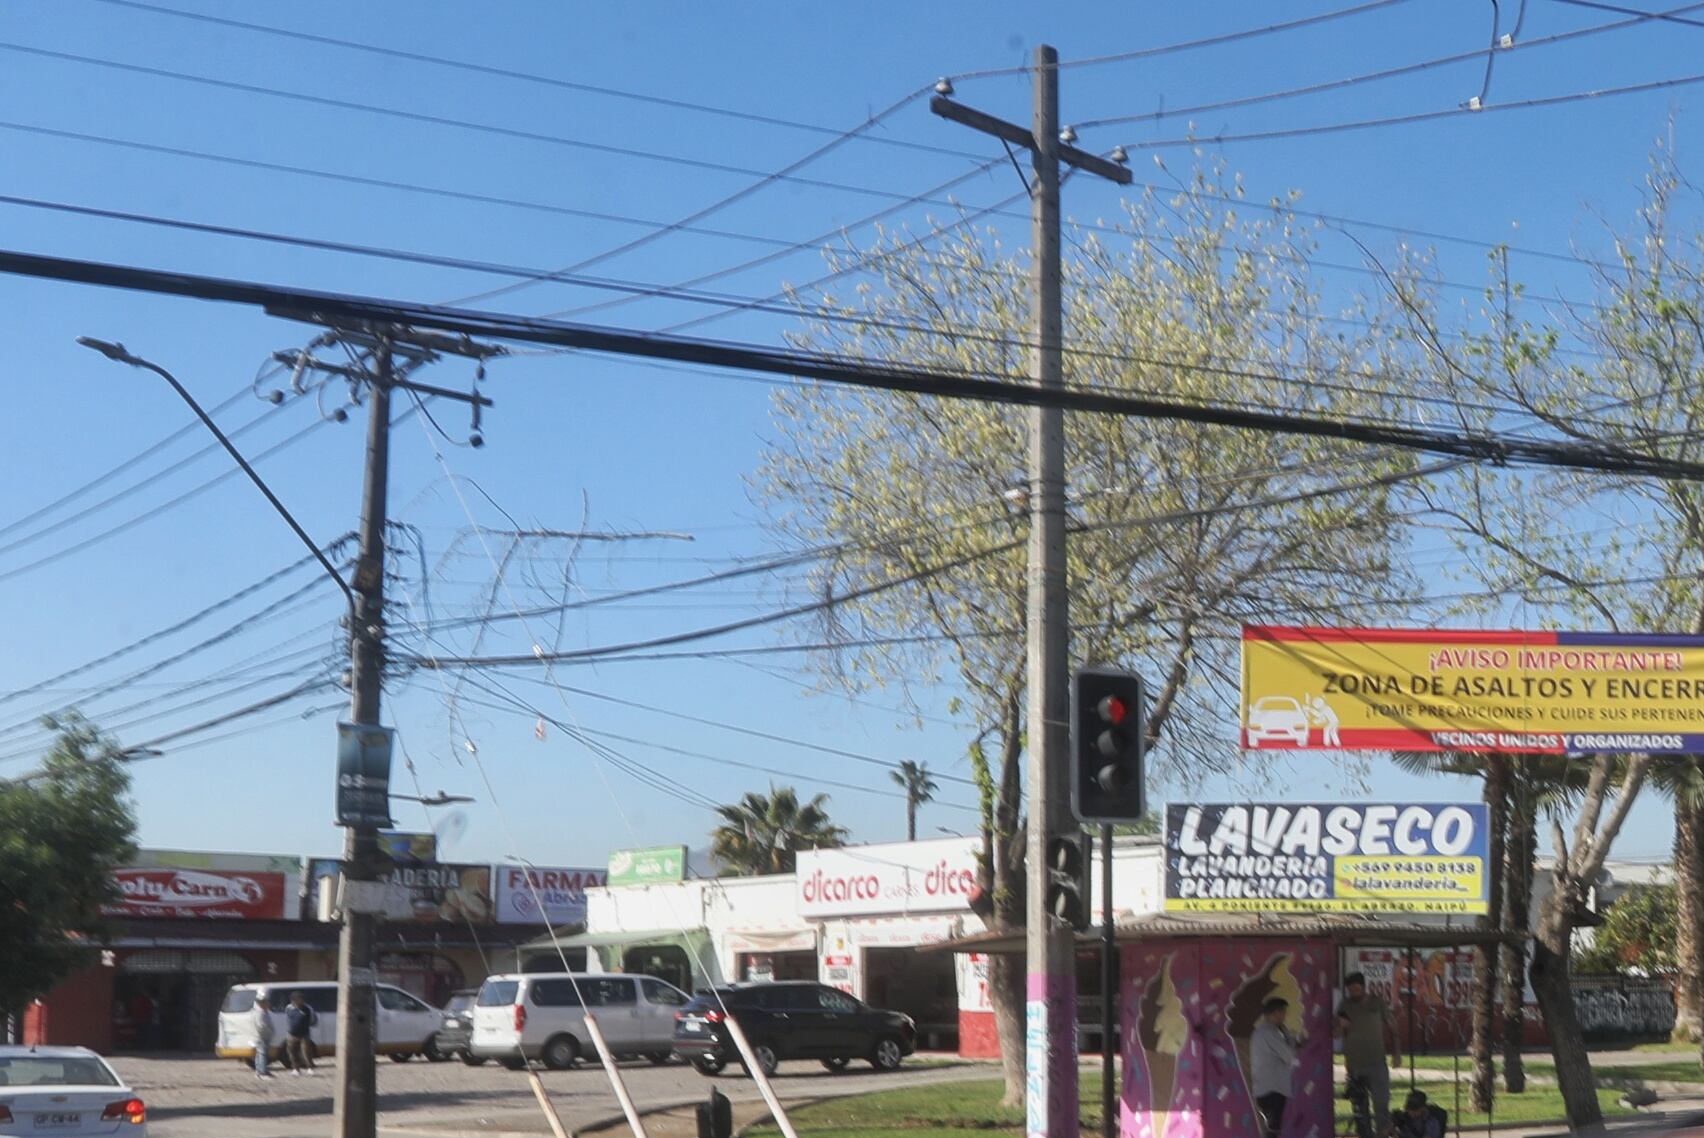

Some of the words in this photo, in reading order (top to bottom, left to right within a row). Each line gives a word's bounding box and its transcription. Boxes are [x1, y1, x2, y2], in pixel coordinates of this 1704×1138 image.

[1430, 648, 1509, 672] ¡AVISO
[1517, 650, 1683, 672] IMPORTANTE!
[1321, 672, 1402, 695] ZONA
[1410, 674, 1445, 697] DE
[1452, 676, 1573, 699] ASALTOS
[1580, 678, 1597, 699] Y
[1418, 704, 1532, 720] PRECAUCIONES
[1536, 708, 1546, 719] Y
[1550, 707, 1595, 721] CUIDE
[1599, 708, 1628, 721] SUS
[1431, 731, 1497, 748] VECINOS
[1499, 733, 1559, 749] UNIDOS
[1559, 733, 1571, 750] Y
[1573, 734, 1684, 750] ORGANIZADOS
[1178, 804, 1475, 857] LAVASECO
[802, 868, 880, 904] dicarco
[1178, 877, 1328, 899] PLANCHADO
